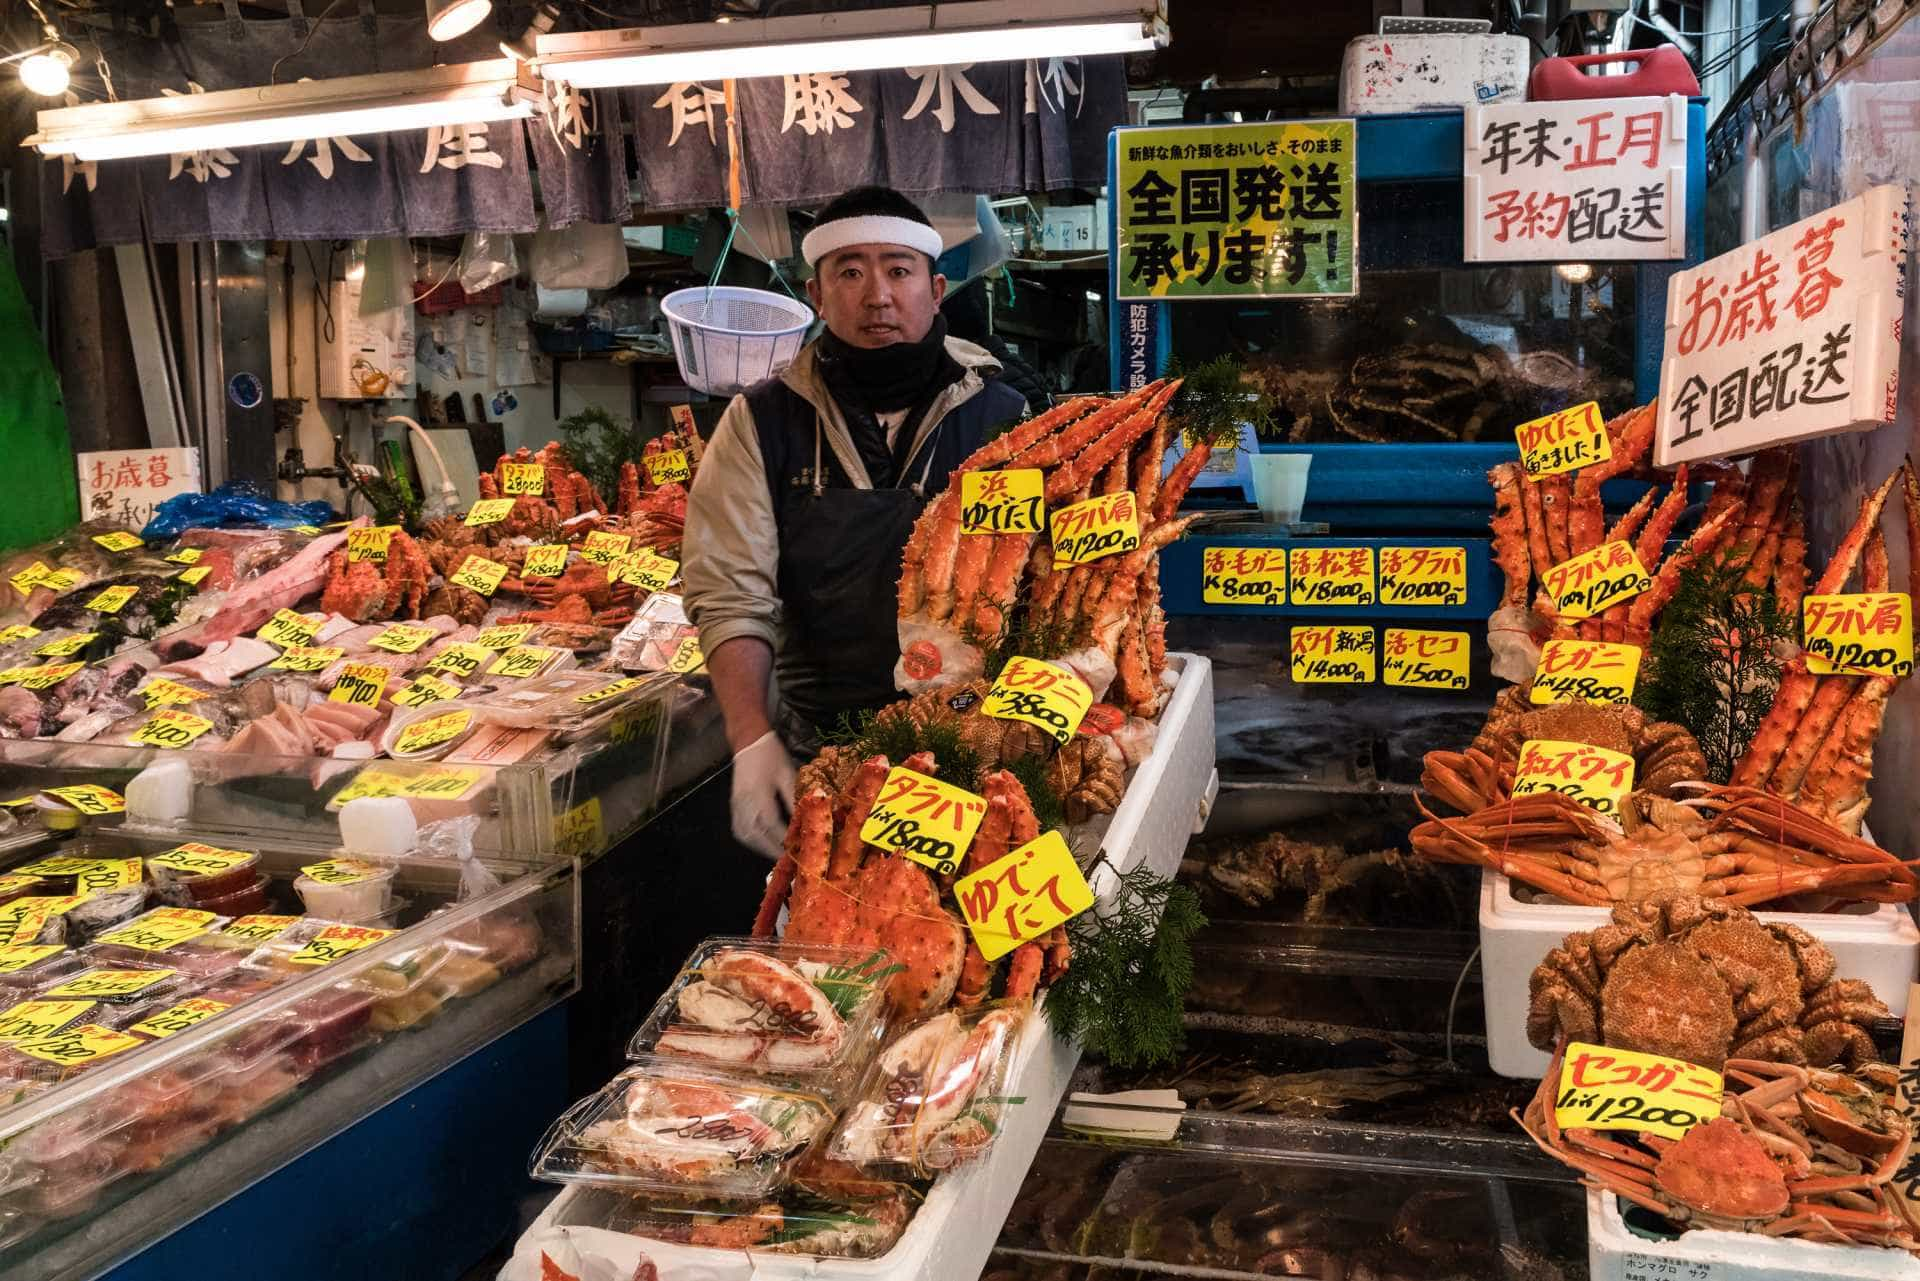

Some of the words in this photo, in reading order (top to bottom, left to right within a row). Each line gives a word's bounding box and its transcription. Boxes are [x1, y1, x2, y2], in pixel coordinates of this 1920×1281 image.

[1127, 162, 1342, 226] 全国発送
[1485, 182, 1666, 244] 予約配送
[1076, 227, 1089, 241] 15
[1677, 215, 1845, 356] お歳暮
[1670, 322, 1851, 448] 全国配送
[91, 456, 173, 489] お歳暮
[646, 451, 681, 472] タラバ
[350, 530, 385, 546] タラバ
[1805, 597, 1901, 636] タラバ肩
[876, 776, 984, 832] タラバ
[1626, 1260, 1677, 1274] ホンマグロ
